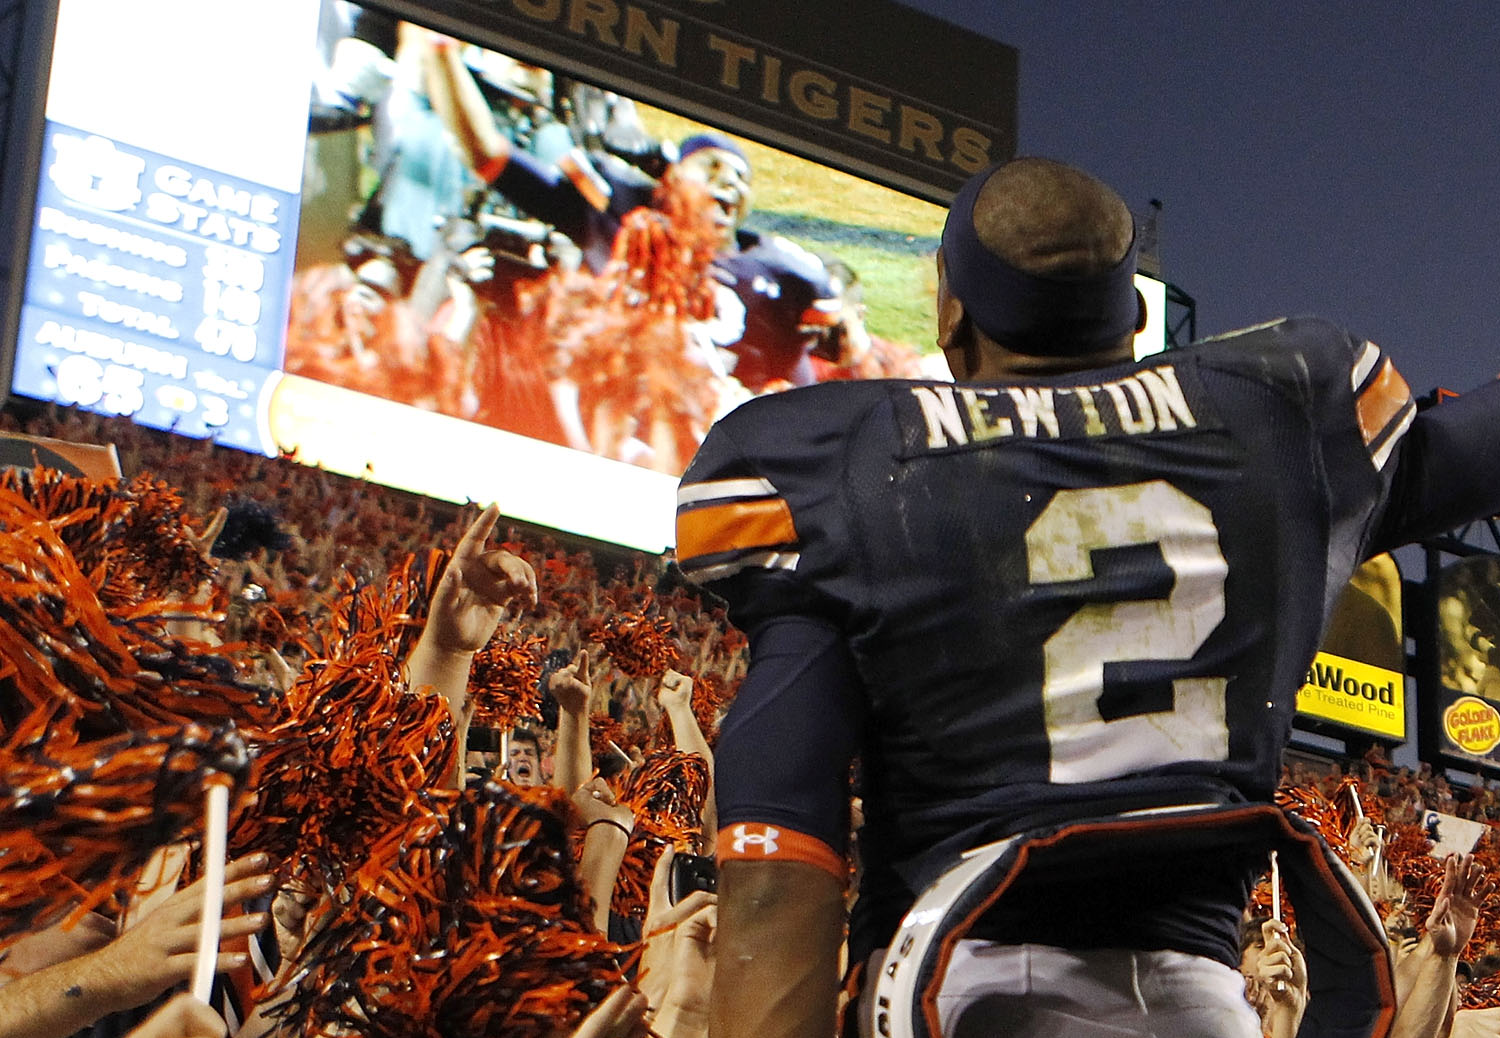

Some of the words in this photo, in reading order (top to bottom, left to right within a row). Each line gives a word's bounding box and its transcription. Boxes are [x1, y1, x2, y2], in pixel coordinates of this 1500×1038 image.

[709, 32, 994, 175] TIGERS
[145, 194, 282, 255] STATS
[154, 165, 281, 225] GAME
[77, 291, 180, 340] TOTAL
[35, 321, 188, 380] AUBURN
[910, 365, 1198, 449] NEWTON
[1024, 479, 1231, 785] 2
[1315, 689, 1364, 712] Treated
[1368, 702, 1396, 720] Pine
[1450, 707, 1494, 729] GOLDEN
[1458, 726, 1496, 745] FLAKE
